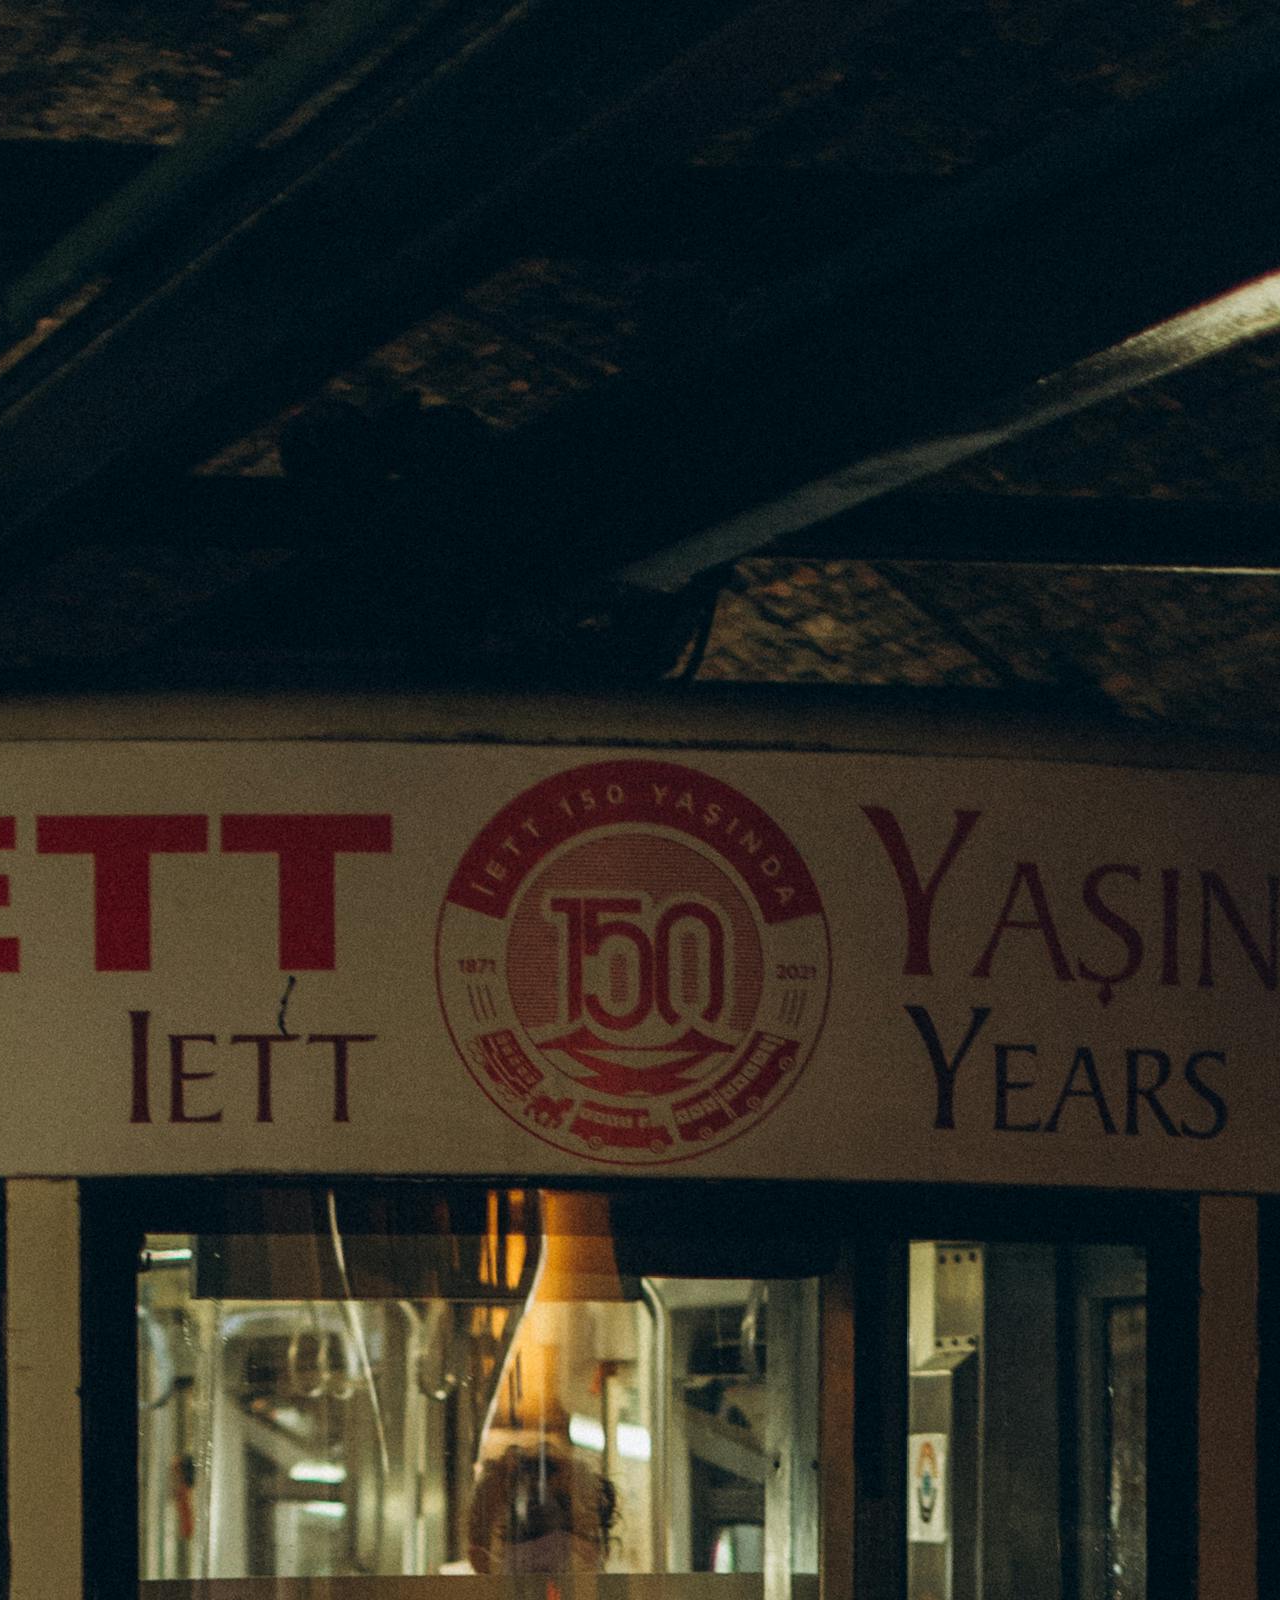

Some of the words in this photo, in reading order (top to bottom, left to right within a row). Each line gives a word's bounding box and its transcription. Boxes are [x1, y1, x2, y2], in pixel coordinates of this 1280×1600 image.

[560, 784, 624, 817] 150
[551, 898, 724, 1031] 150
[776, 964, 818, 981] 2021
[905, 1005, 1229, 1139] YEARS
